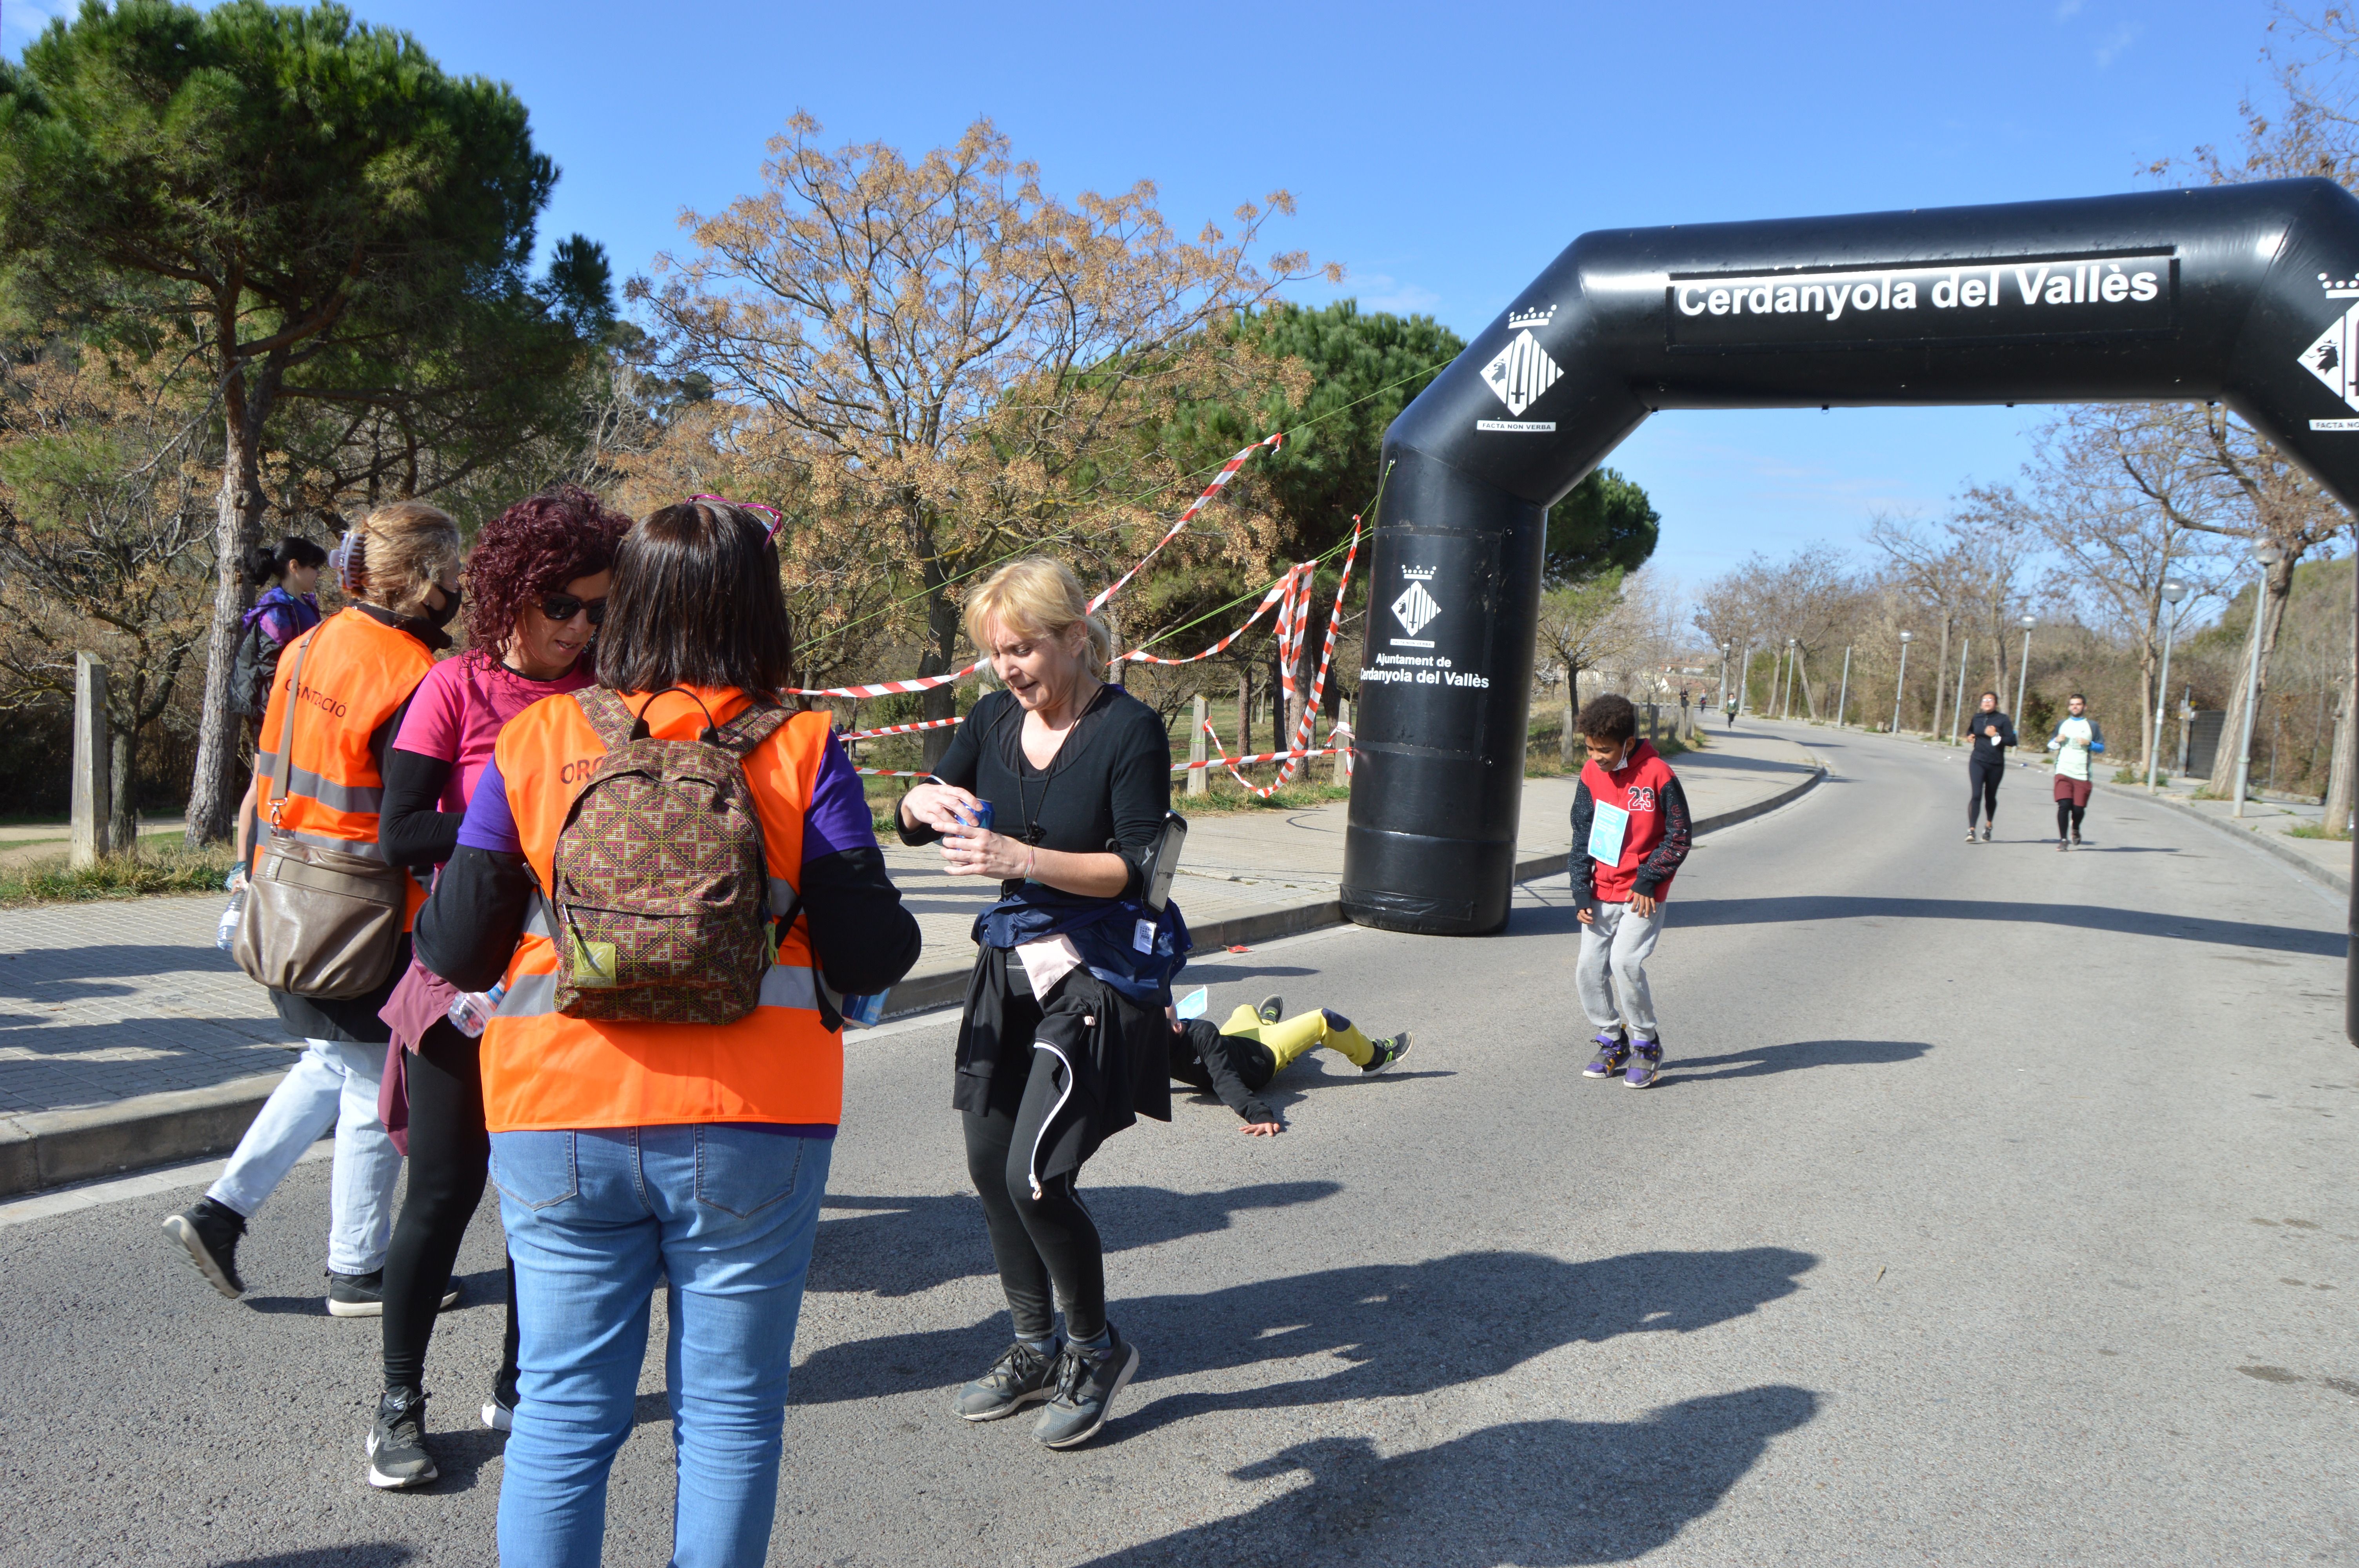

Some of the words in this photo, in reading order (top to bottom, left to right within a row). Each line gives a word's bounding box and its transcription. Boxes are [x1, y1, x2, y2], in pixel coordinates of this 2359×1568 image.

[1679, 274, 1917, 321] Cerdanyola
[1932, 270, 1999, 309] del
[2015, 264, 2158, 305] Vallès
[1376, 653, 1434, 666] Ajuntament
[1436, 656, 1452, 668] de
[1360, 667, 1412, 684] Cerdanyola
[1416, 670, 1440, 684] del
[1444, 671, 1489, 688] Vallès
[1628, 786, 1656, 812] 23
